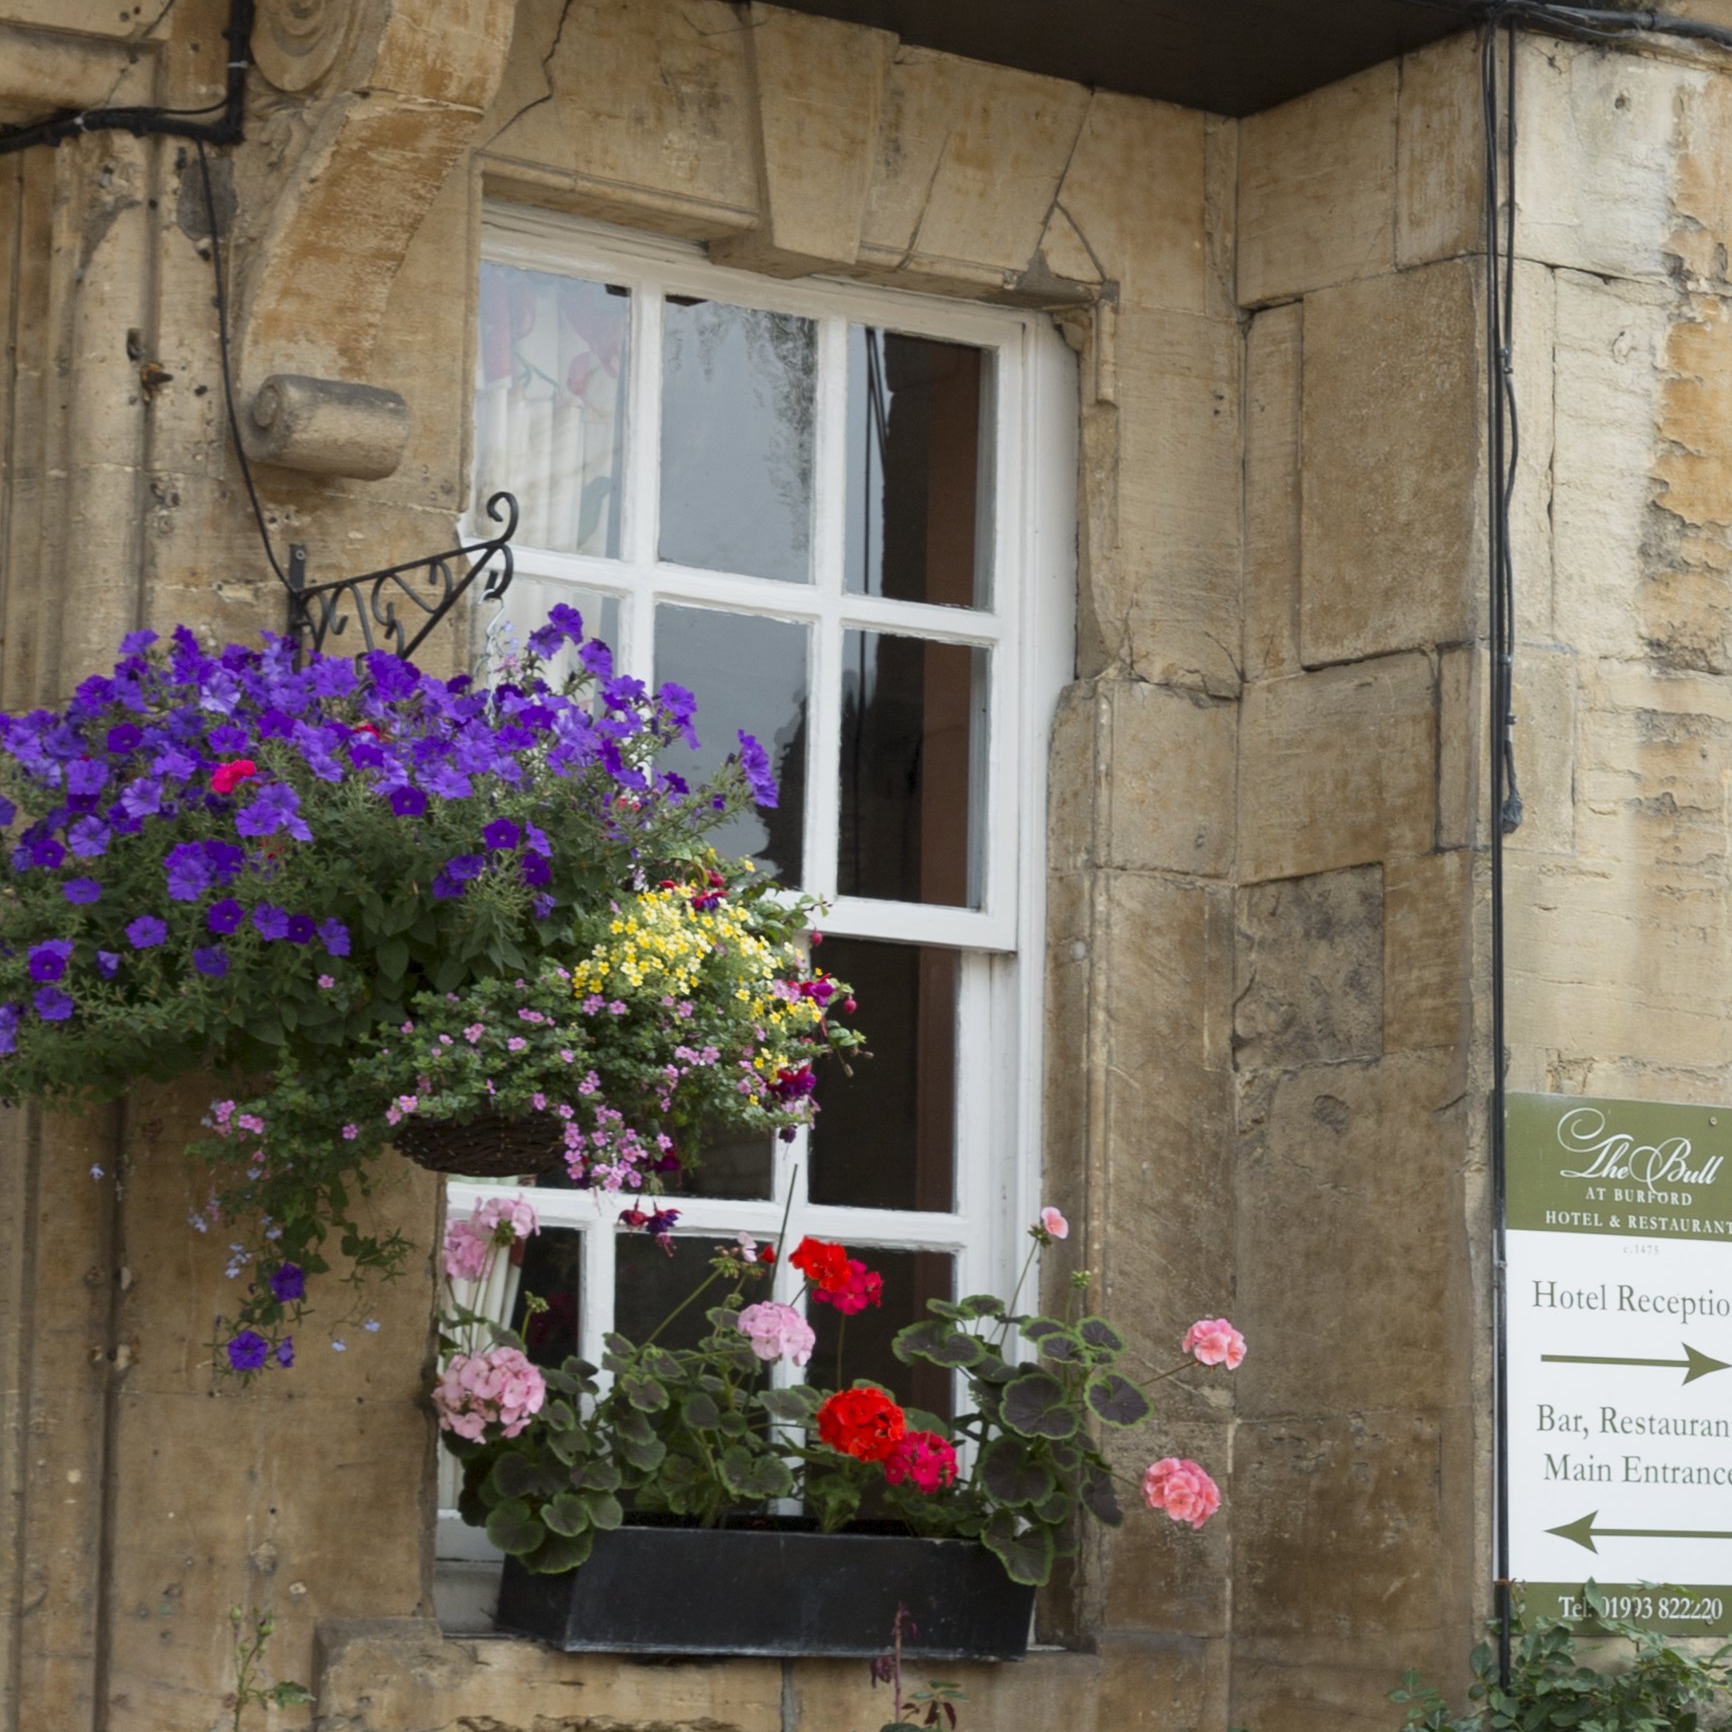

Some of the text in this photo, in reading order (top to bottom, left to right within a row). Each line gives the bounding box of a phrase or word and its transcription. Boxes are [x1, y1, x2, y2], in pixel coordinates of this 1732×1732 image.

[1557, 1107, 1724, 1196] The Bull
[1585, 1187, 1693, 1206] AT BURFORD
[1545, 1210, 1603, 1228] HOTEL
[1609, 1215, 1621, 1228] &
[1531, 1280, 1607, 1311] Hotel
[1536, 1404, 1590, 1438] Bar,
[1543, 1453, 1613, 1483] Main
